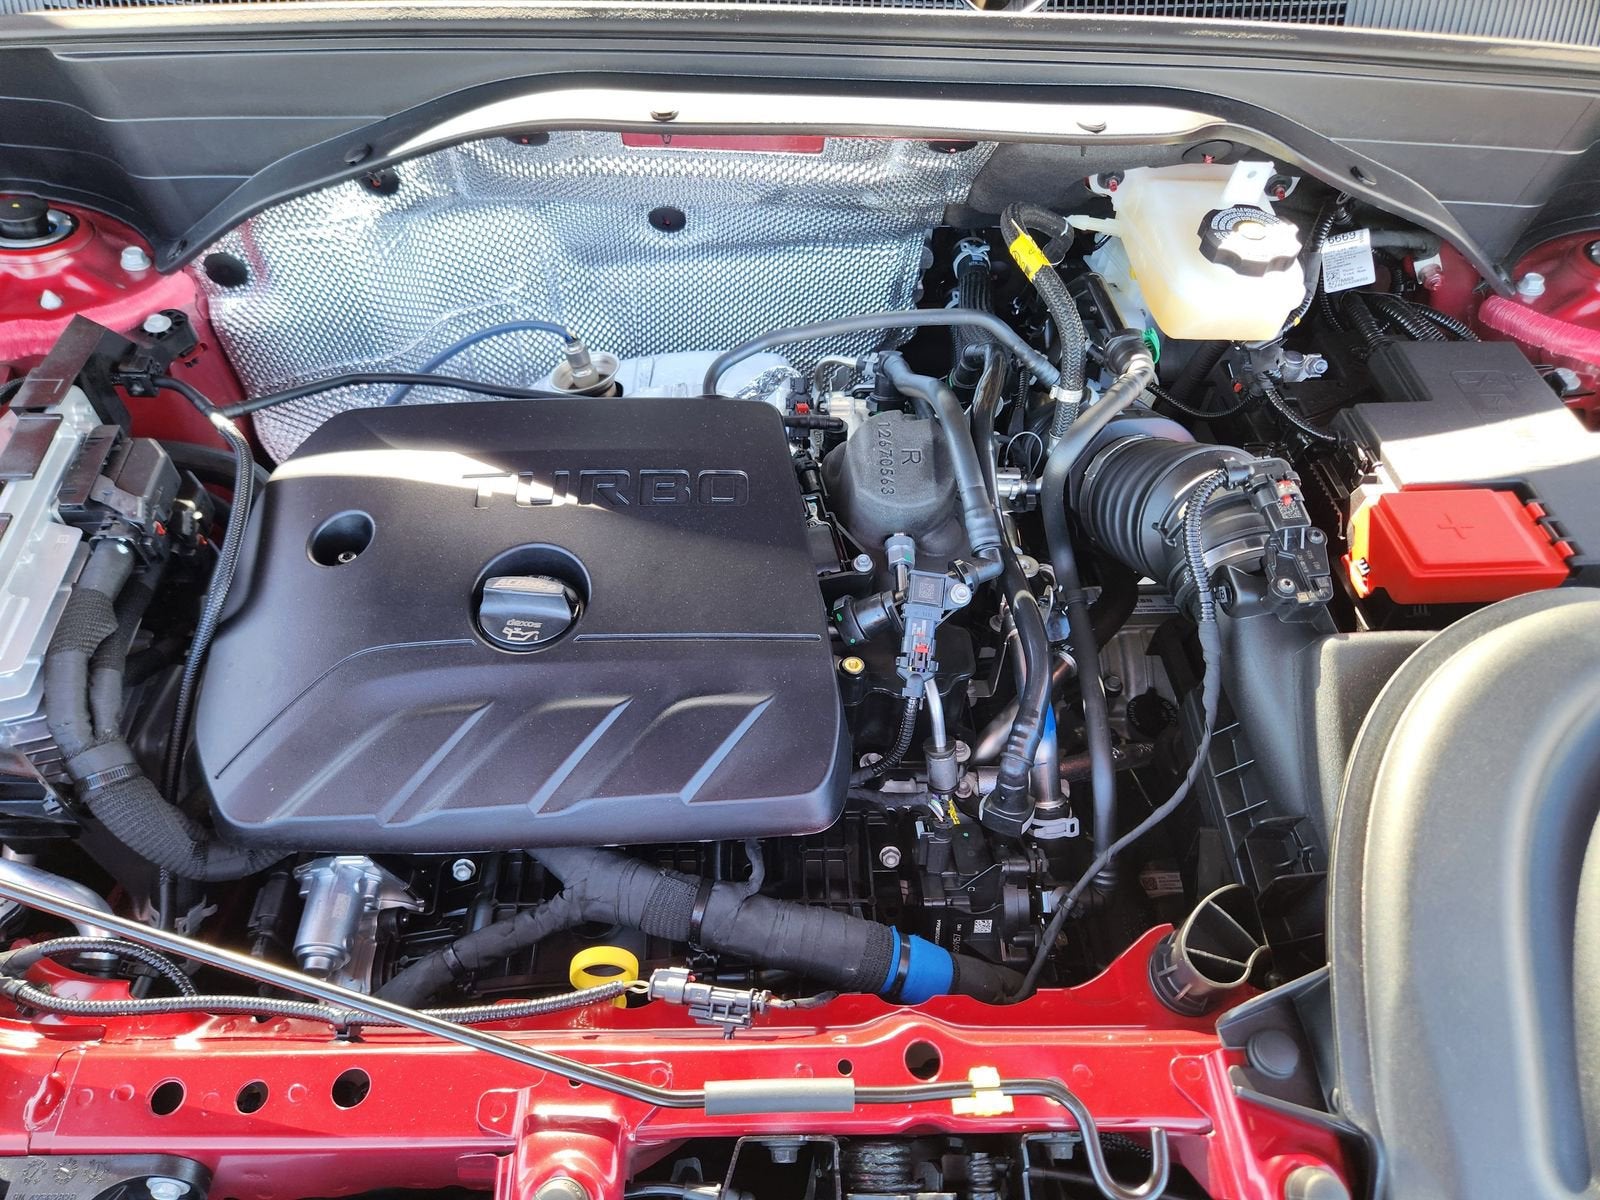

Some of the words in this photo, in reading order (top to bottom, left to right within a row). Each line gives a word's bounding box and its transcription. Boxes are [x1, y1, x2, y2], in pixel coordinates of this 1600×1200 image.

[877, 421, 895, 495] 12670563
[901, 448, 922, 465] R
[461, 469, 749, 508] TURBO
[506, 618, 543, 628] dexos
